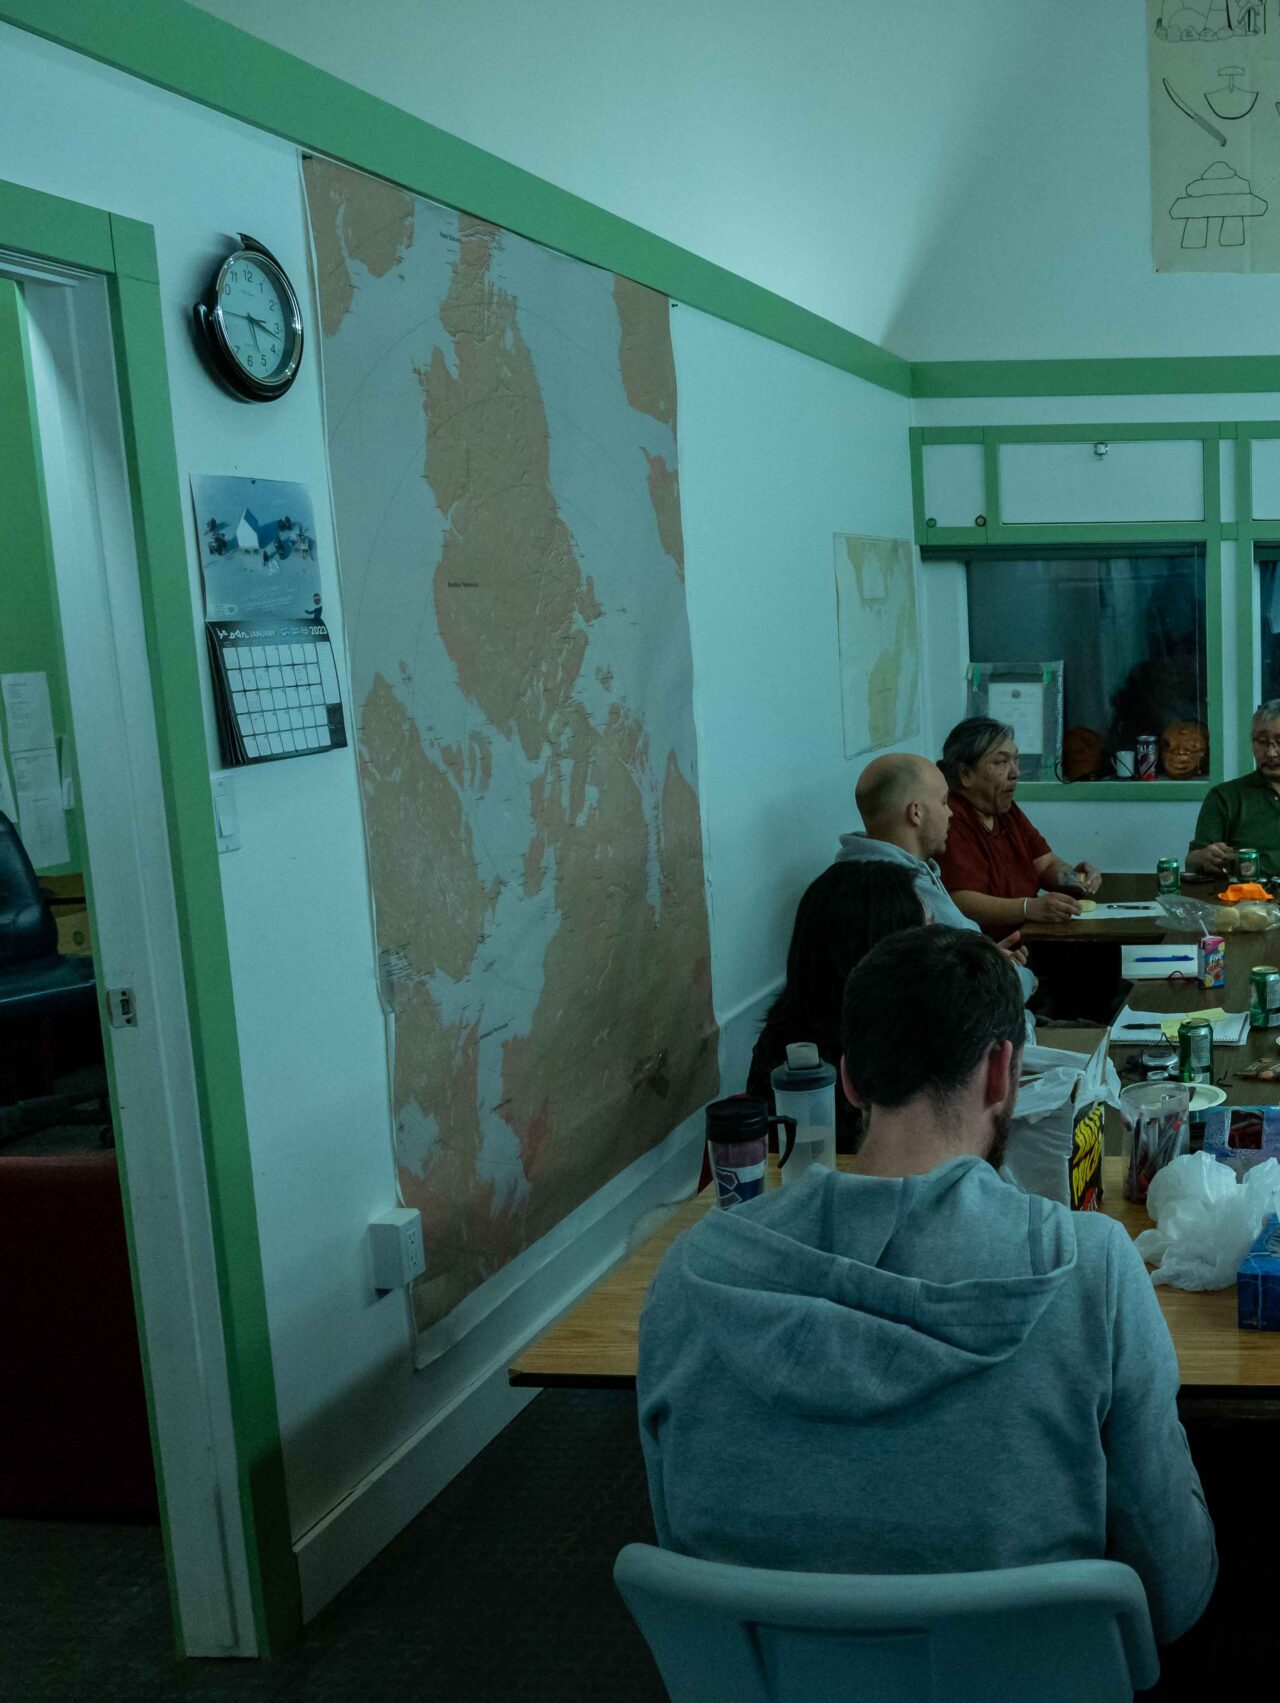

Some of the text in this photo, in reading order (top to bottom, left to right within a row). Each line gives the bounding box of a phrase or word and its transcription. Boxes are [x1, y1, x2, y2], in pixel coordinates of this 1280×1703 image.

[230, 270, 238, 284] 11
[243, 270, 253, 283] 12
[259, 283, 263, 294] 1
[269, 300, 275, 312] 2
[274, 323, 280, 334] 3
[271, 345, 276, 355] 4
[247, 355, 253, 368] 6
[261, 354, 267, 367] 5
[309, 625, 328, 636] 2023
